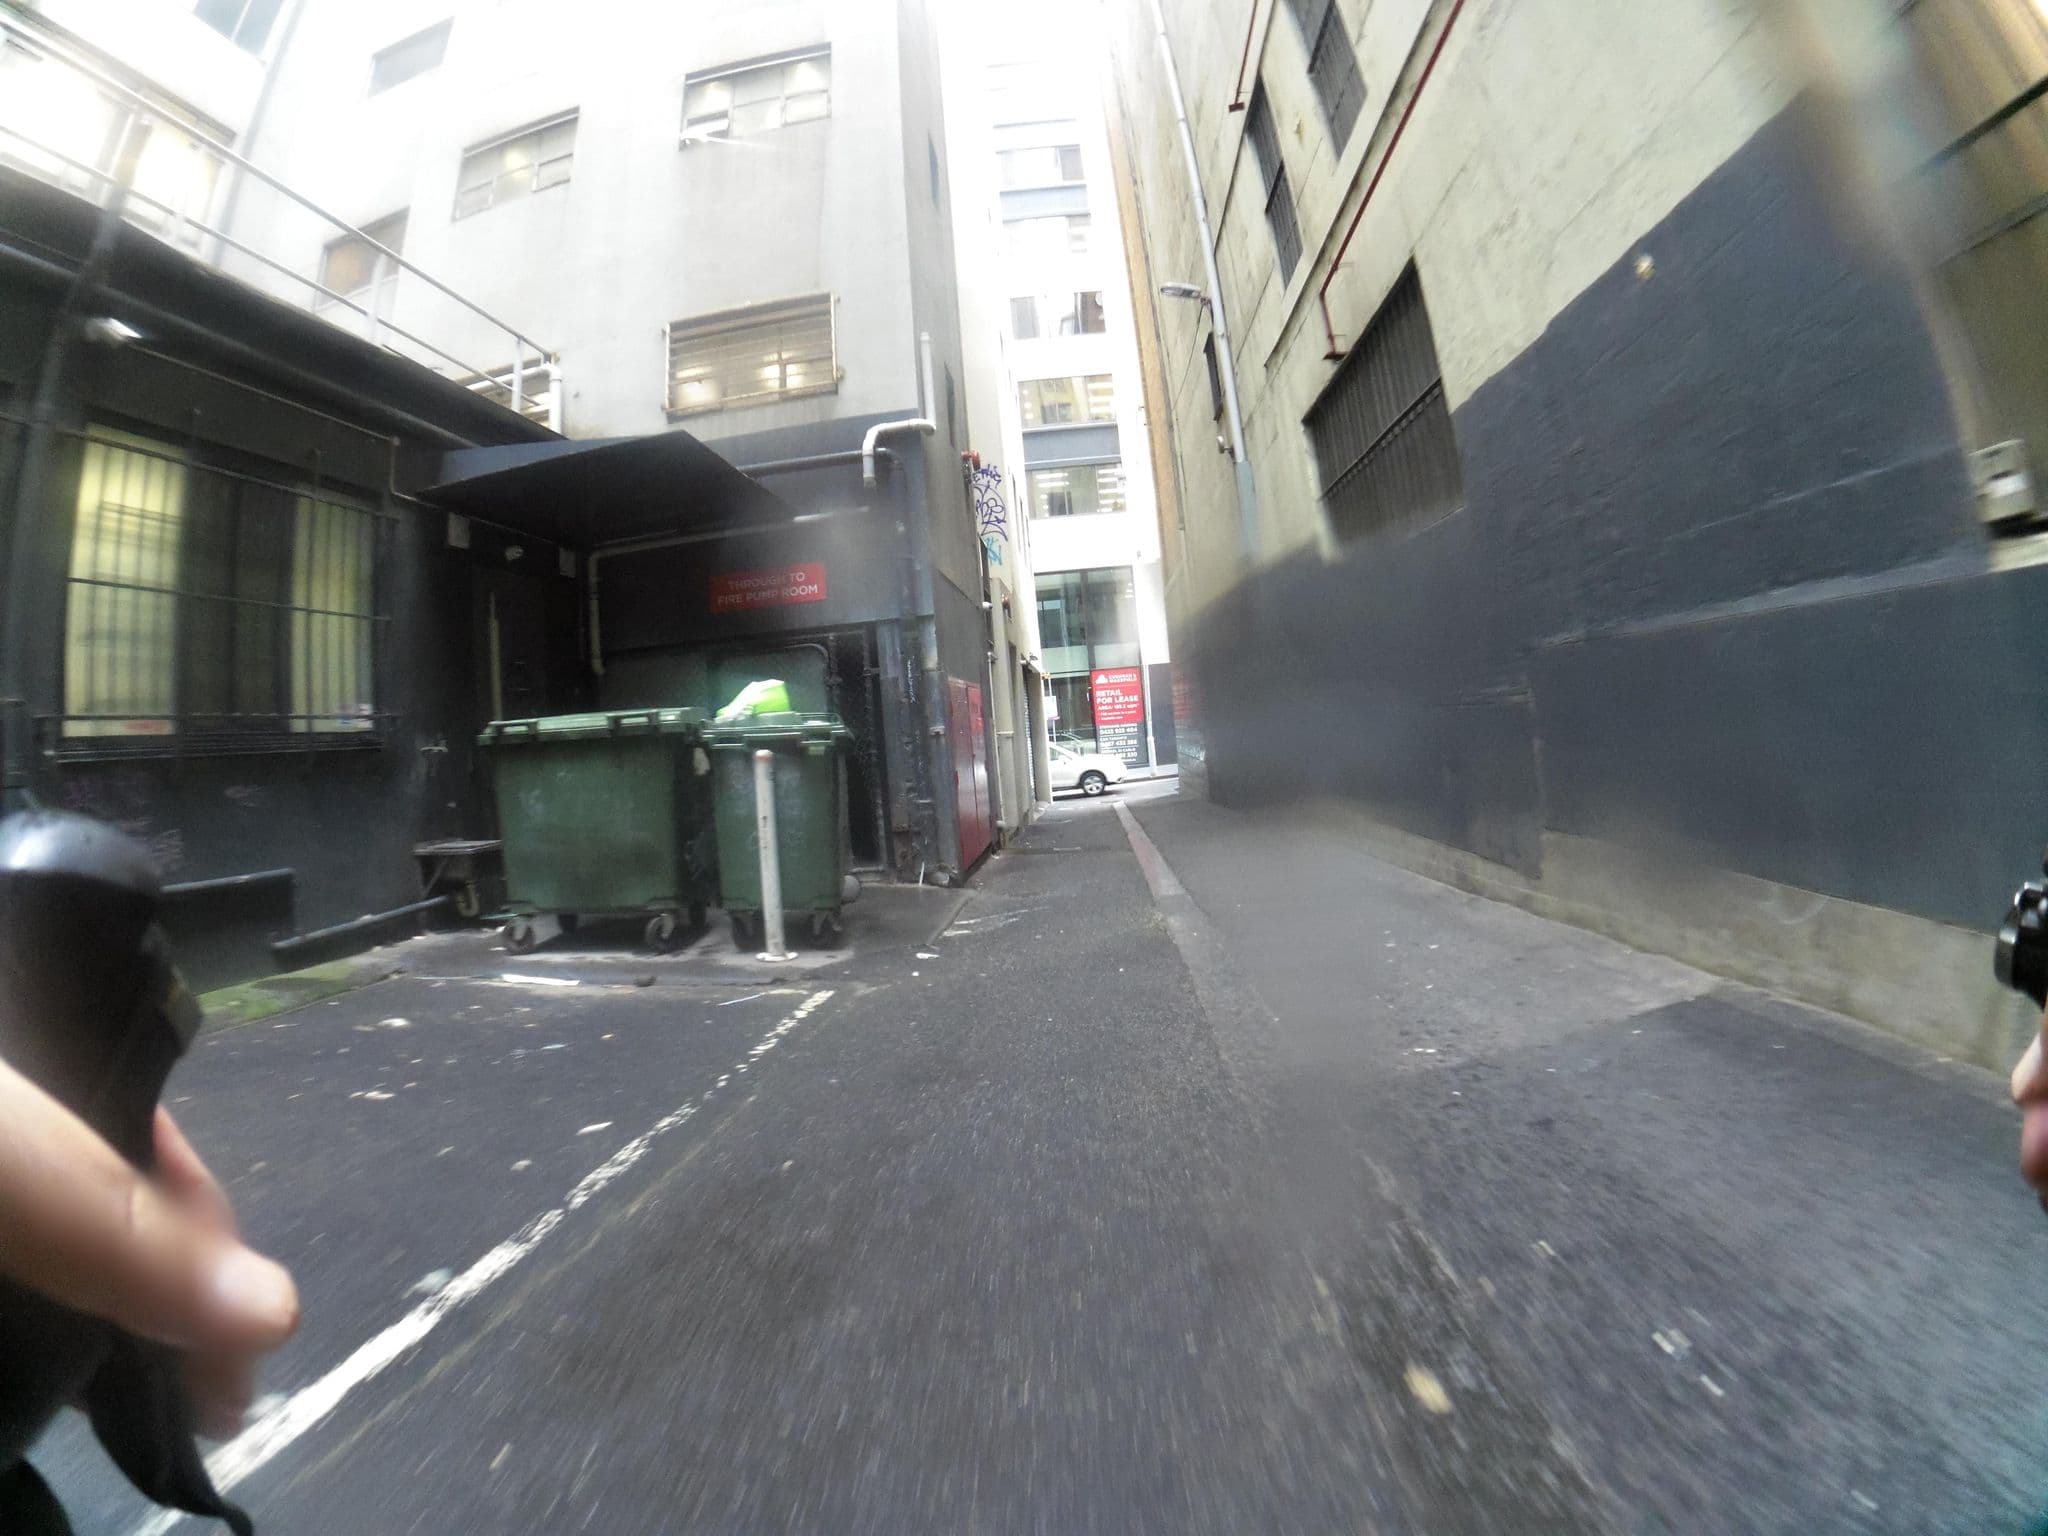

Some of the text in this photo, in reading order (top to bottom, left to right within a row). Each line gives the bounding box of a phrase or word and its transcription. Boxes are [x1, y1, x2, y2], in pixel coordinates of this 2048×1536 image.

[790, 572, 805, 582] TO
[717, 584, 818, 606] FIRE PUMP ROOM
